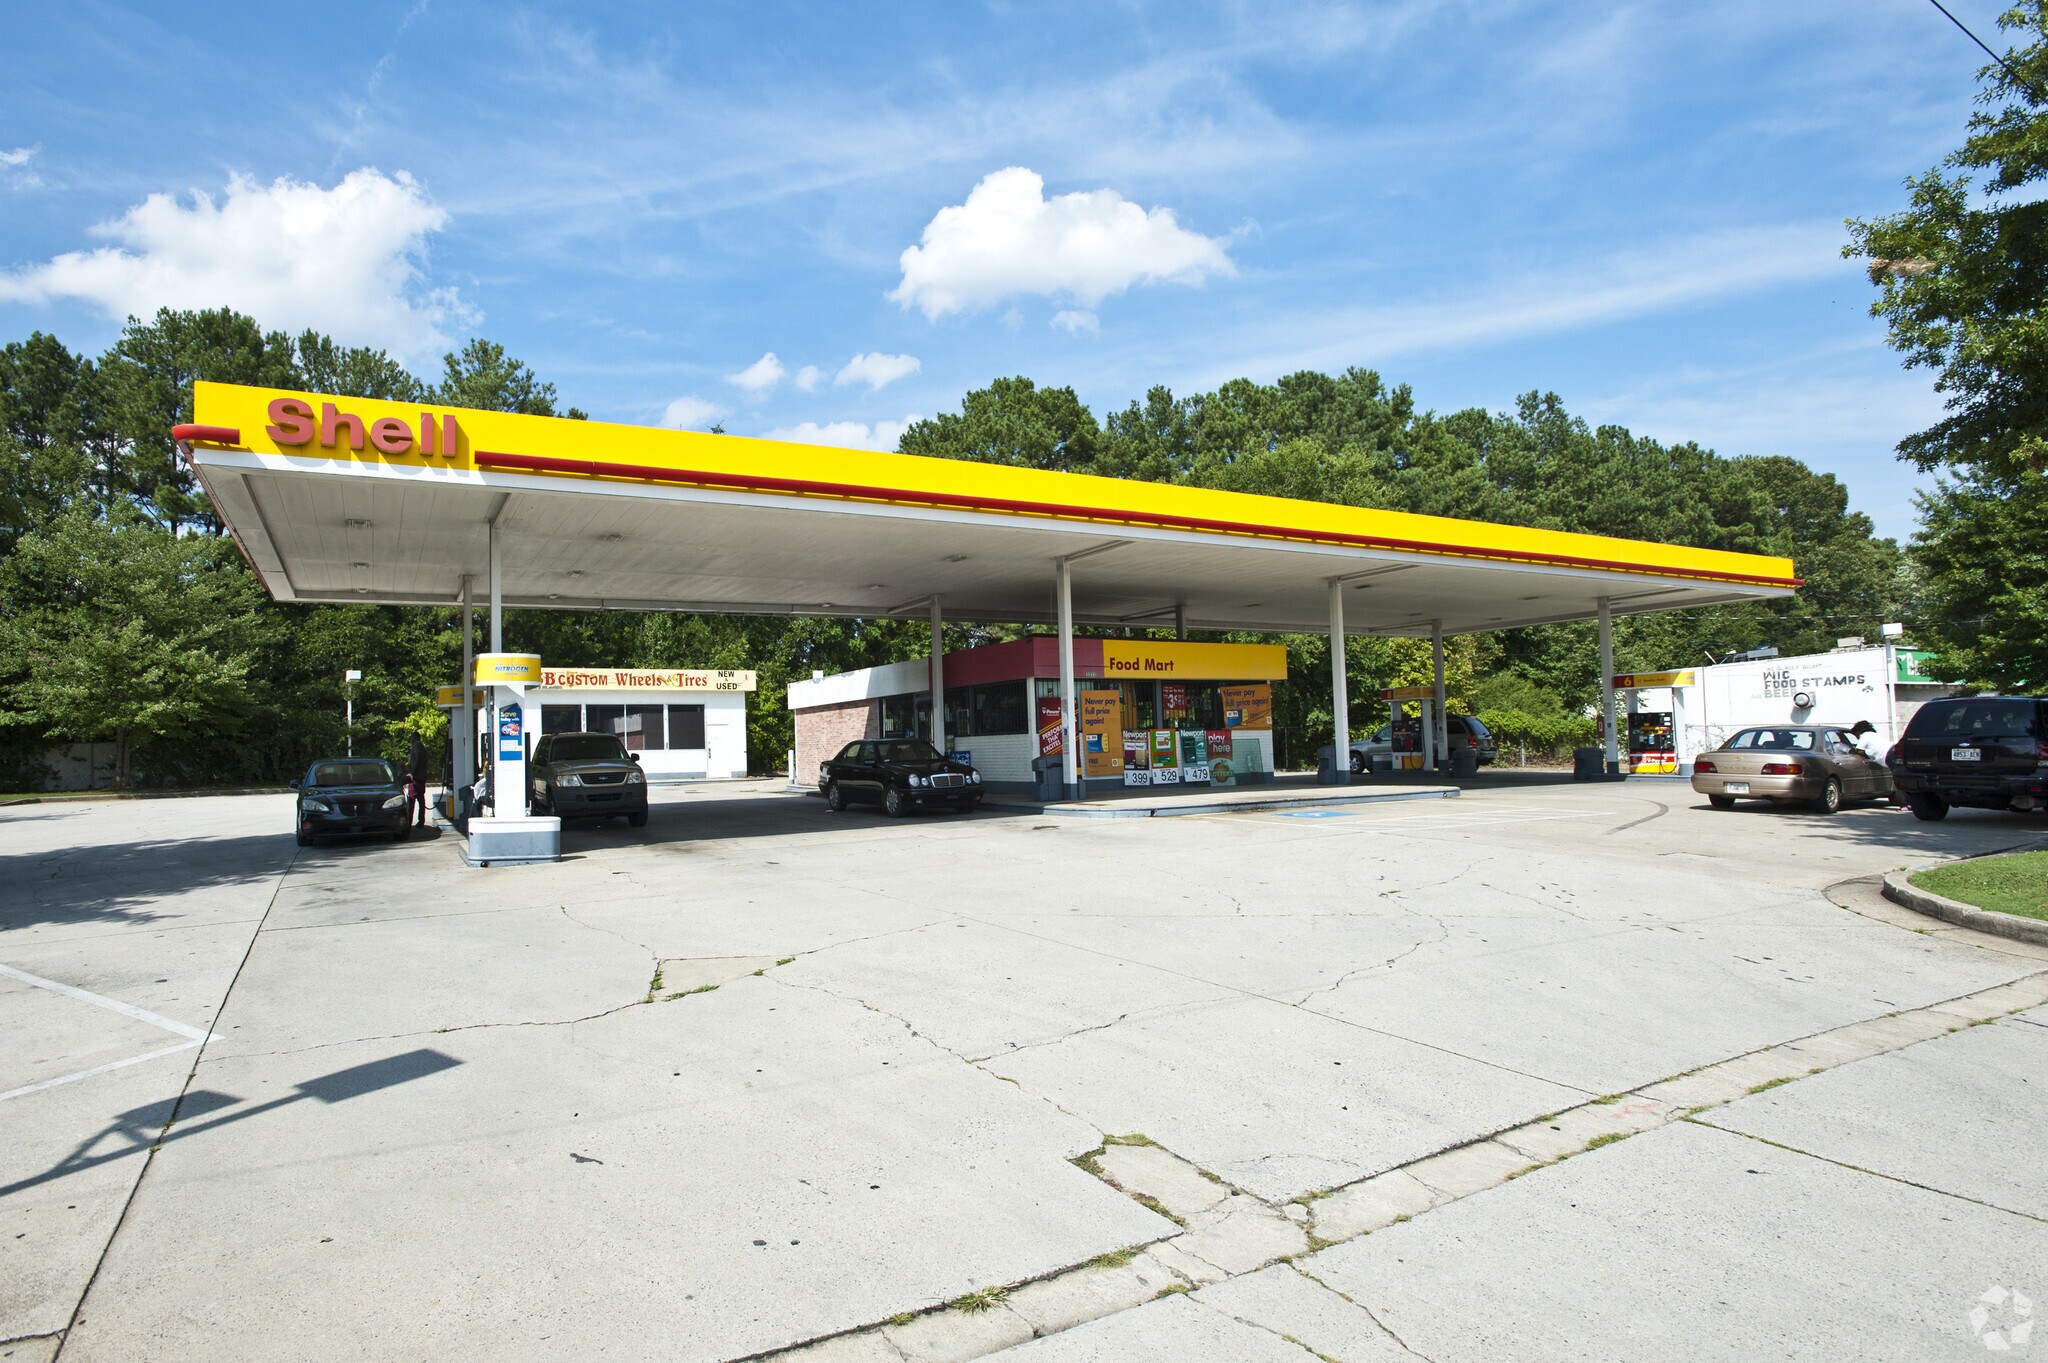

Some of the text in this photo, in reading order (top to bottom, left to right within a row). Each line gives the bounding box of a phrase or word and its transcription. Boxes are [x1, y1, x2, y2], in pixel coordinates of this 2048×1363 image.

[265, 397, 457, 458] Shell
[1109, 657, 1174, 671] Food Mart
[558, 673, 608, 686] CUSTOM
[615, 672, 661, 686] Wheels
[677, 672, 708, 686] Tires
[718, 670, 735, 678] NEW
[1763, 670, 1790, 680] WIC
[716, 682, 738, 690] USED
[1624, 677, 1632, 686] 6
[1764, 675, 1865, 689] FOOD STAMPS
[1236, 698, 1250, 708] price
[1096, 707, 1110, 716] price
[1085, 717, 1104, 725] again!
[1123, 730, 1147, 739] Newport
[1180, 730, 1205, 738] Newport
[1208, 733, 1225, 745] play
[1213, 743, 1230, 753] here
